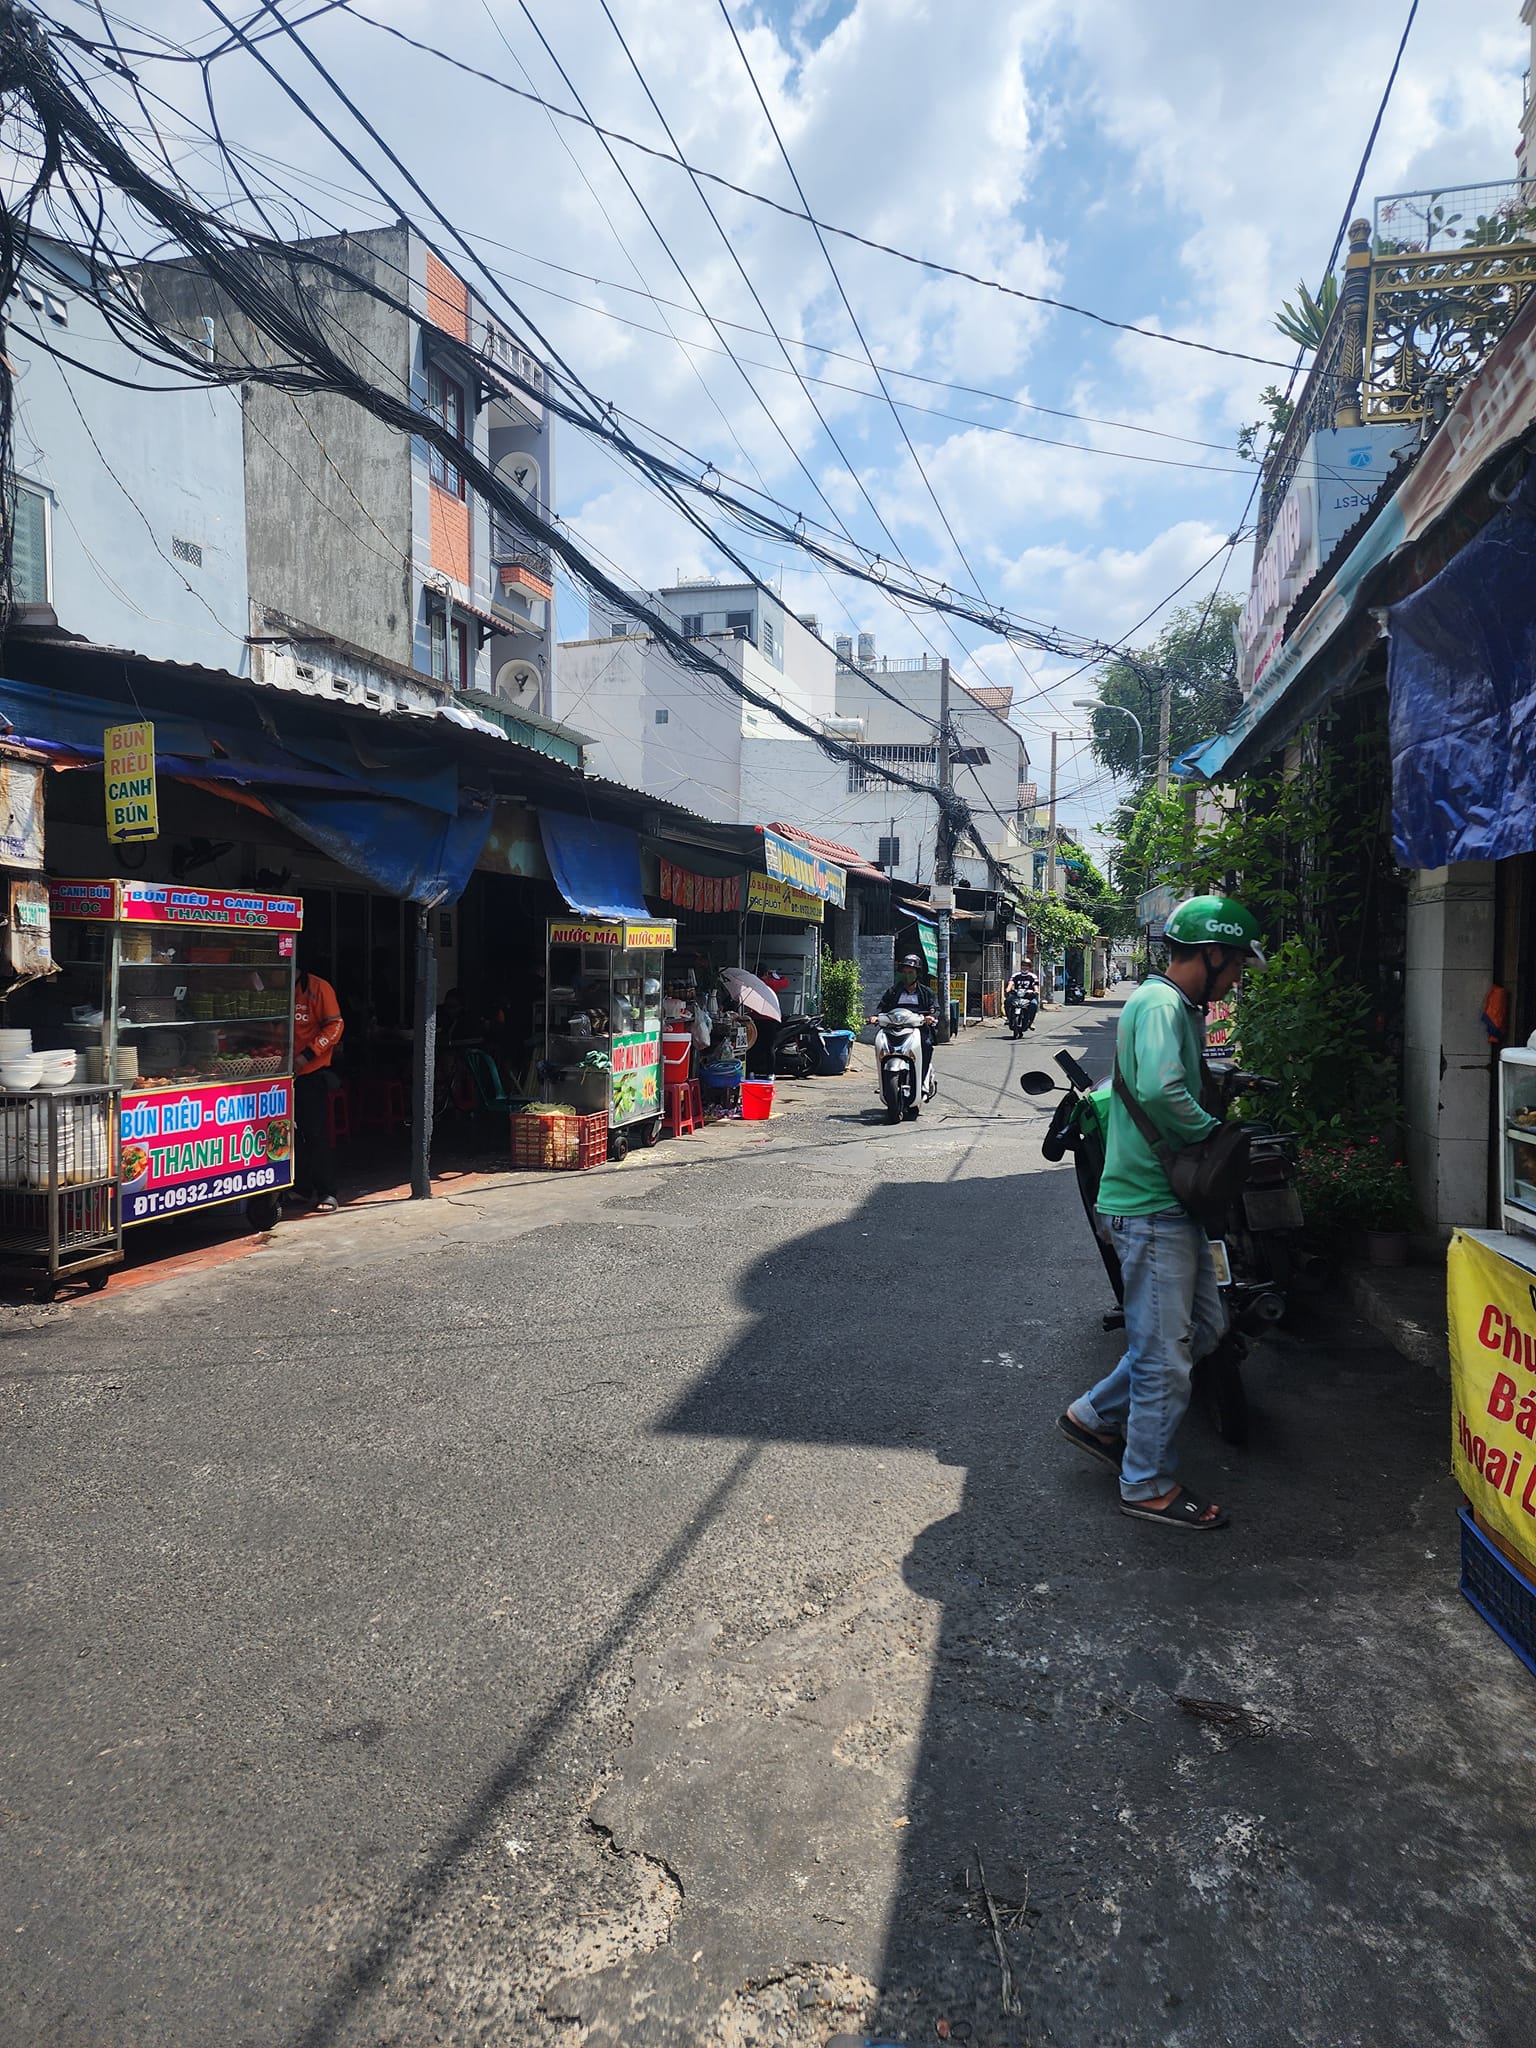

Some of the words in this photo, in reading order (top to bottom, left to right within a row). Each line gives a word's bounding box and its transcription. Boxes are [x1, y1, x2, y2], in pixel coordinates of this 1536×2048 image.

[112, 727, 145, 751] BÚN
[110, 752, 148, 776] RIÊU
[108, 778, 152, 801] CANH
[114, 801, 148, 825] BÚN
[60, 886, 87, 898] CANH
[89, 885, 111, 899] BÚN
[132, 889, 166, 903] BÚN
[171, 892, 209, 906] RIÊU
[224, 898, 263, 910] CANH
[267, 899, 295, 913] BÚN
[70, 899, 101, 915] LỘC
[165, 907, 229, 923] THANH
[235, 909, 268, 926] LỘC
[553, 927, 591, 943] NƯỚC
[593, 929, 619, 945] MÍA
[628, 930, 654, 946] NƯỚC
[656, 930, 671, 945] MÍA
[1205, 919, 1243, 937] Grab
[121, 1100, 159, 1140] BÚN
[162, 1096, 202, 1133] RIÊU
[216, 1094, 257, 1124] CANH
[259, 1084, 287, 1118] BÚN
[150, 1137, 224, 1179] THANH
[229, 1125, 268, 1166] LỘC
[133, 1167, 275, 1216] ĐT:0932.290.669
